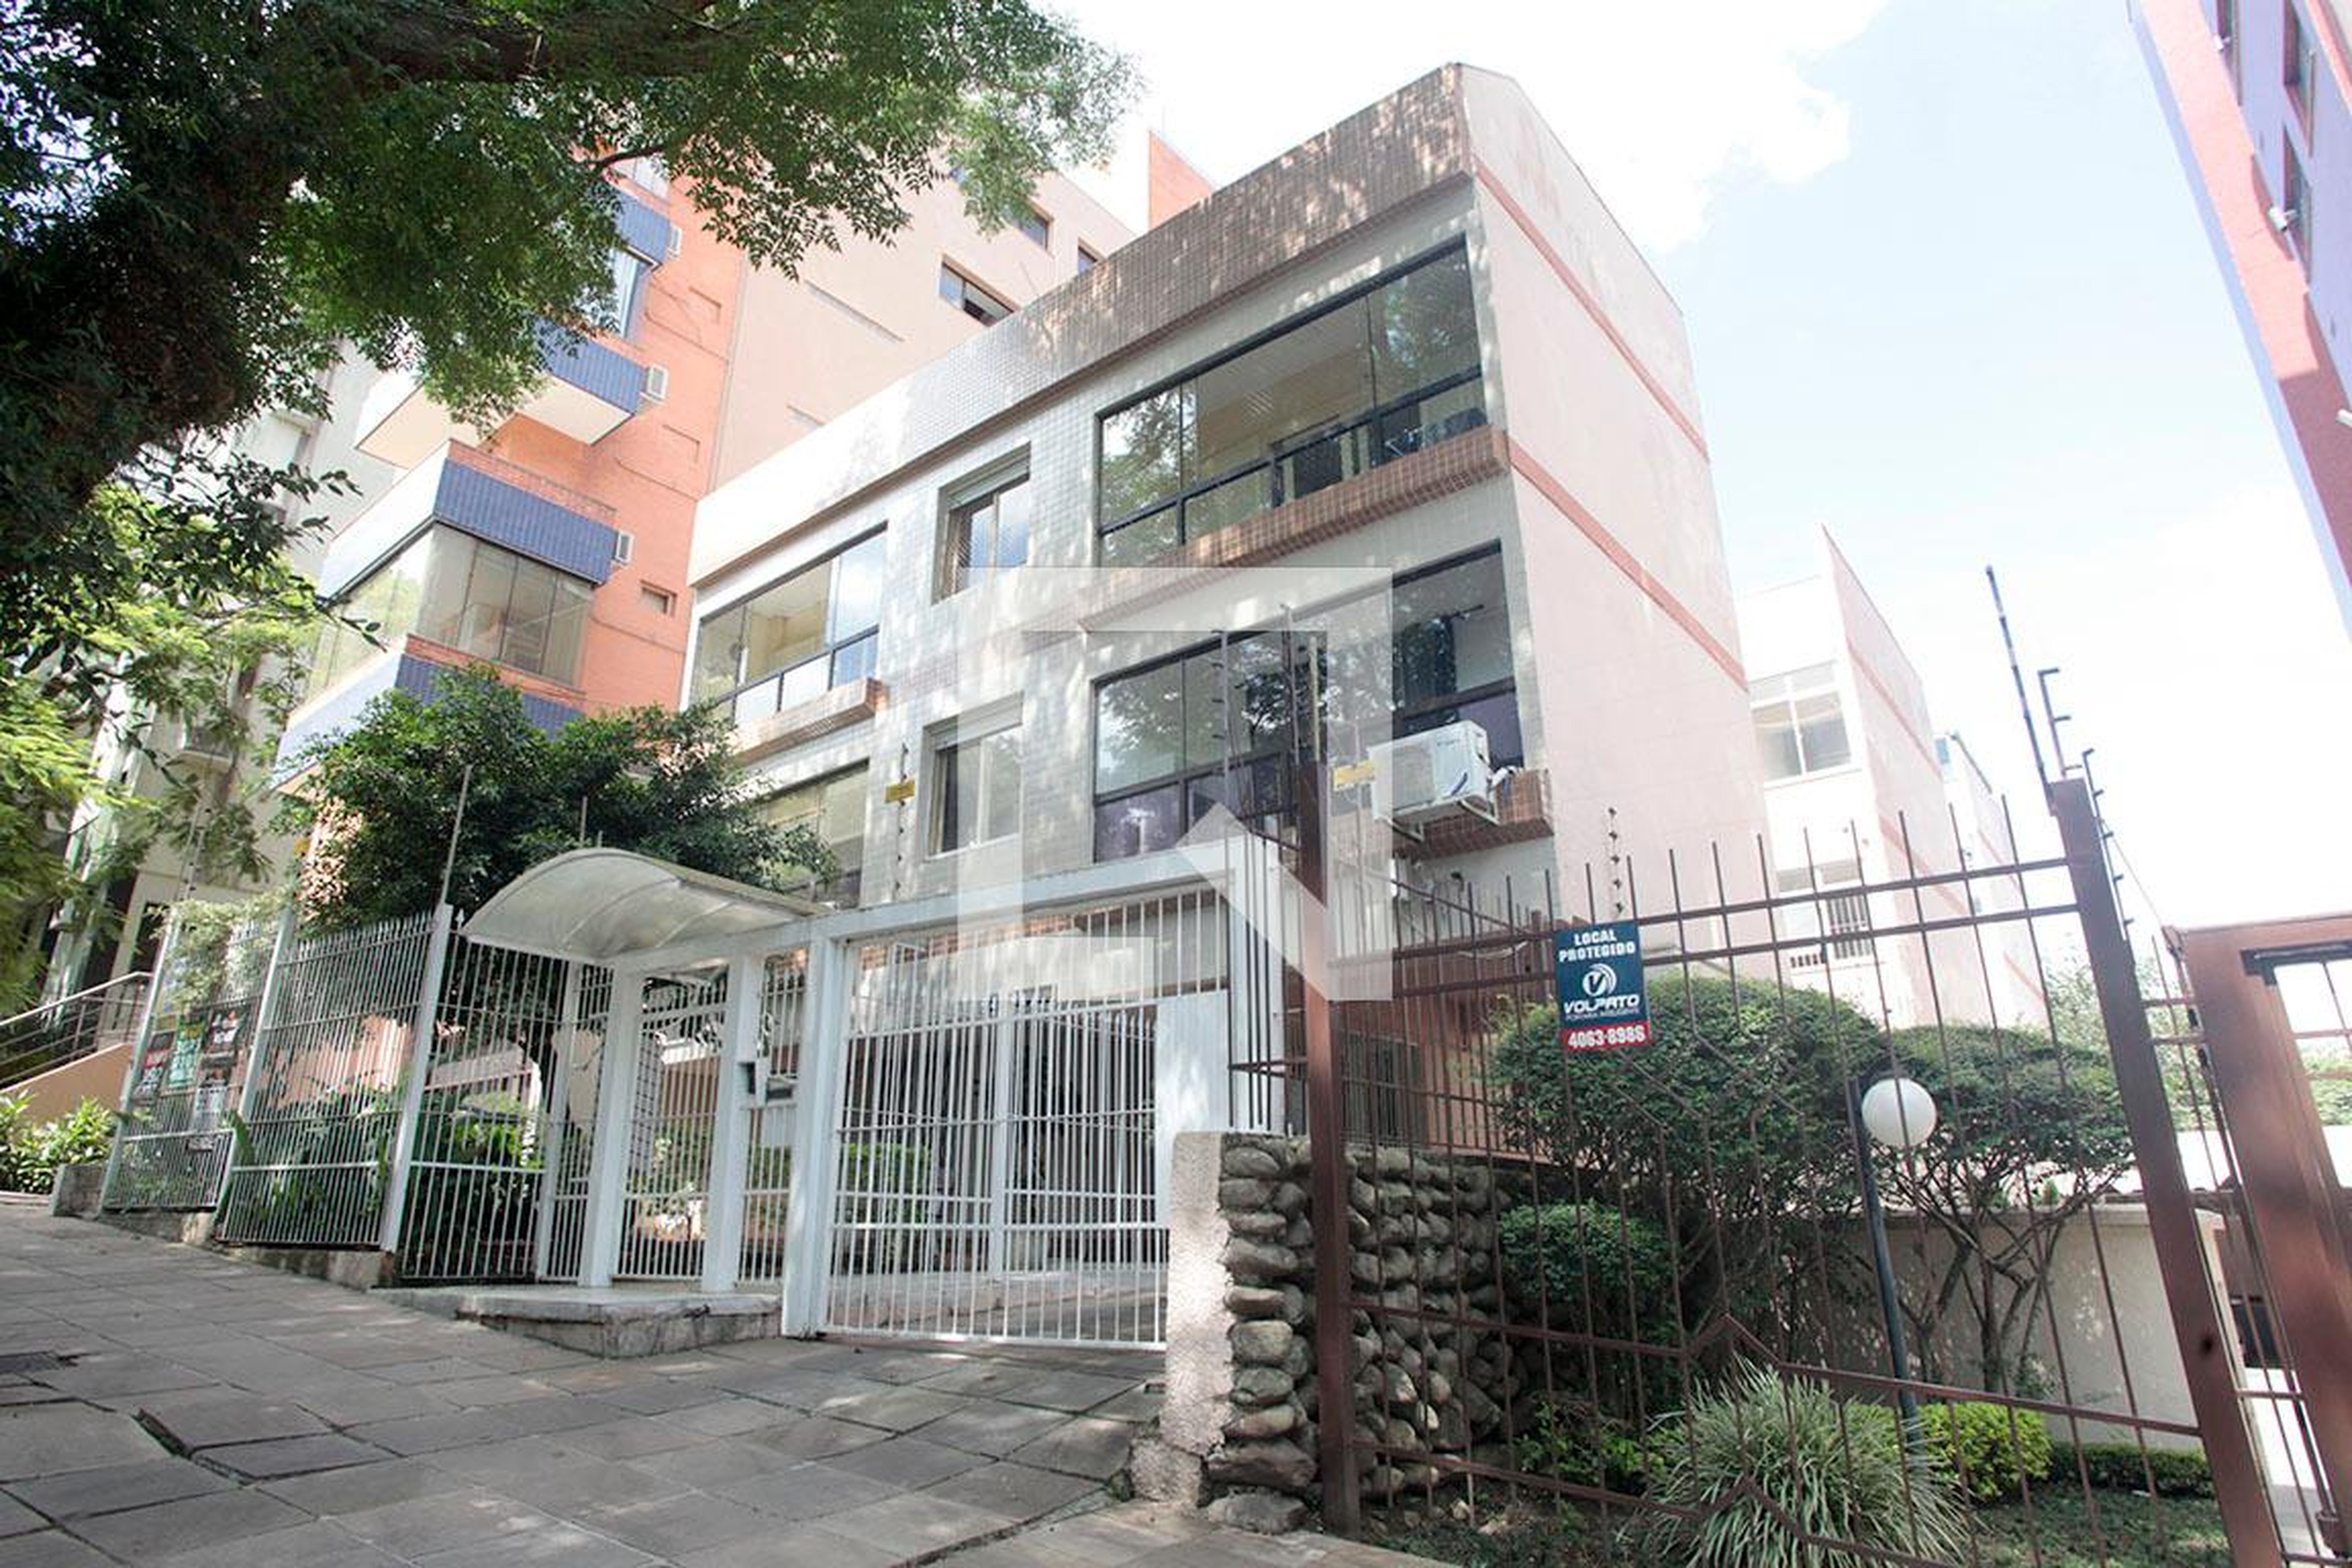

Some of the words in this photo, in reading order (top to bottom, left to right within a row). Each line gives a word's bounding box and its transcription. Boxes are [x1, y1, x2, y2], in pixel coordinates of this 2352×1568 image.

[1574, 929, 1617, 946] LOCAL
[1558, 941, 1636, 962] PROTEGIDO
[1563, 994, 1640, 1014] VOLPATO
